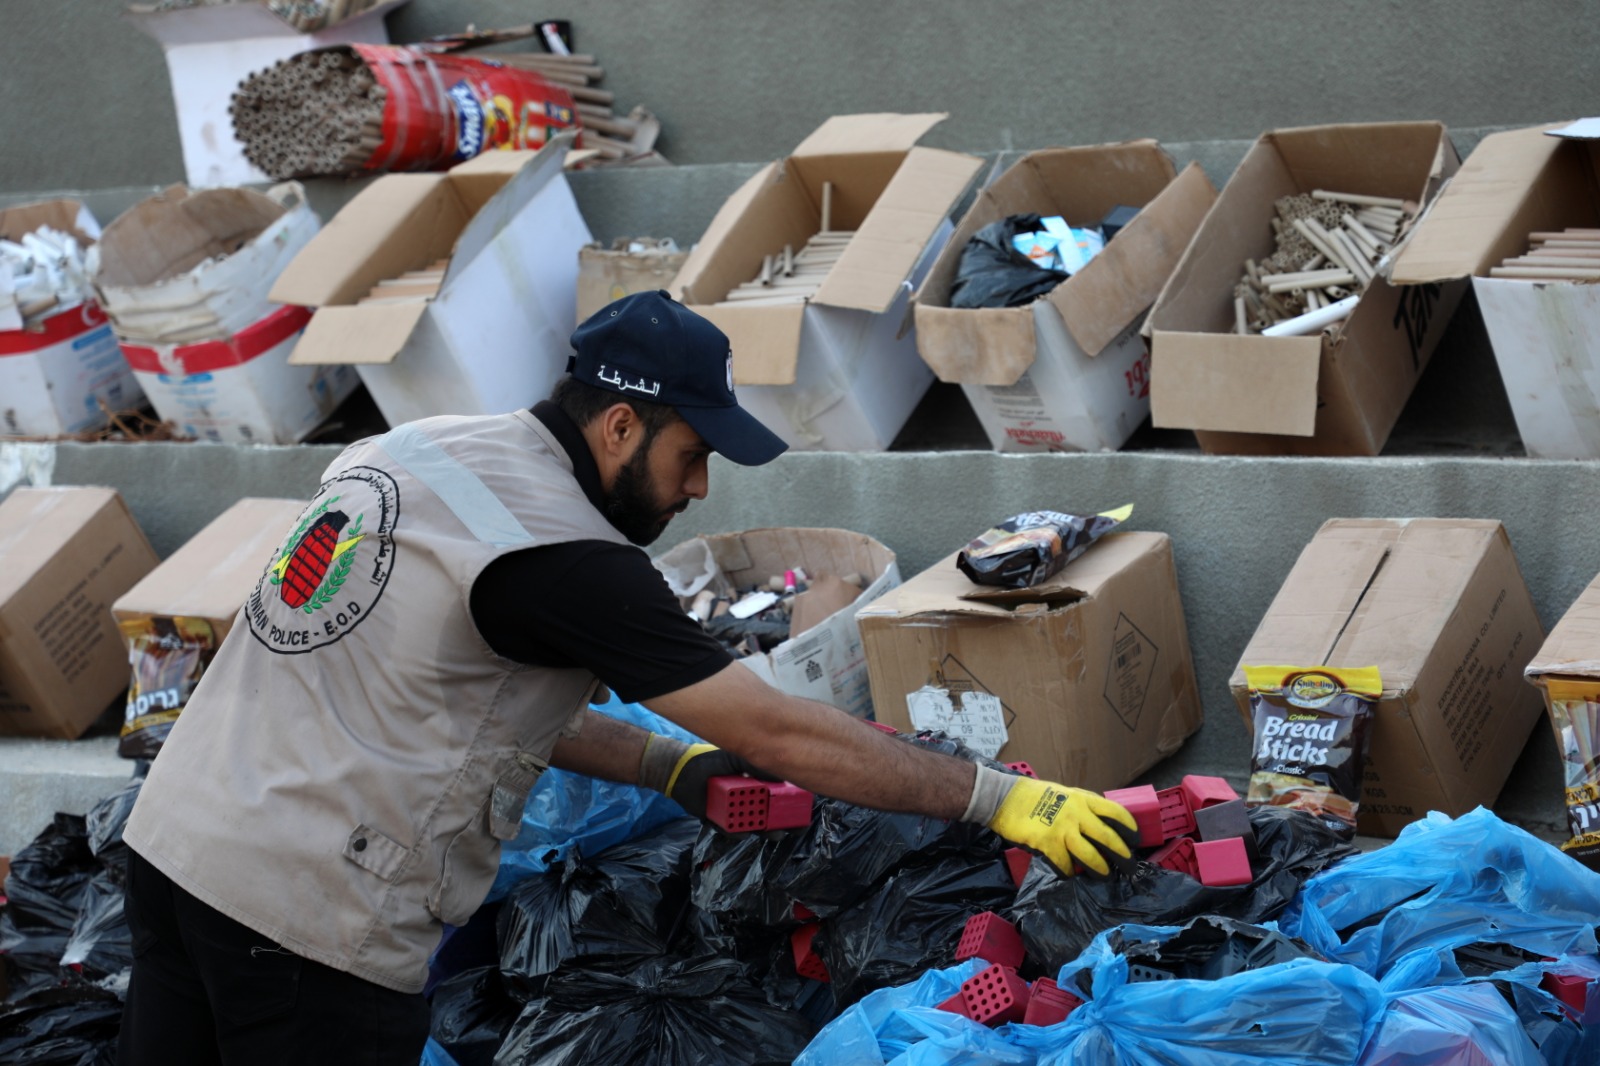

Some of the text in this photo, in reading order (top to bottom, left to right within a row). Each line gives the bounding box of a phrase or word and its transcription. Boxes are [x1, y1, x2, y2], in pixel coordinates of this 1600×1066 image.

[597, 365, 661, 396] الشرطة
[269, 624, 309, 646] POLICE
[1262, 716, 1338, 741] Bread
[1258, 737, 1329, 765] Sticks
